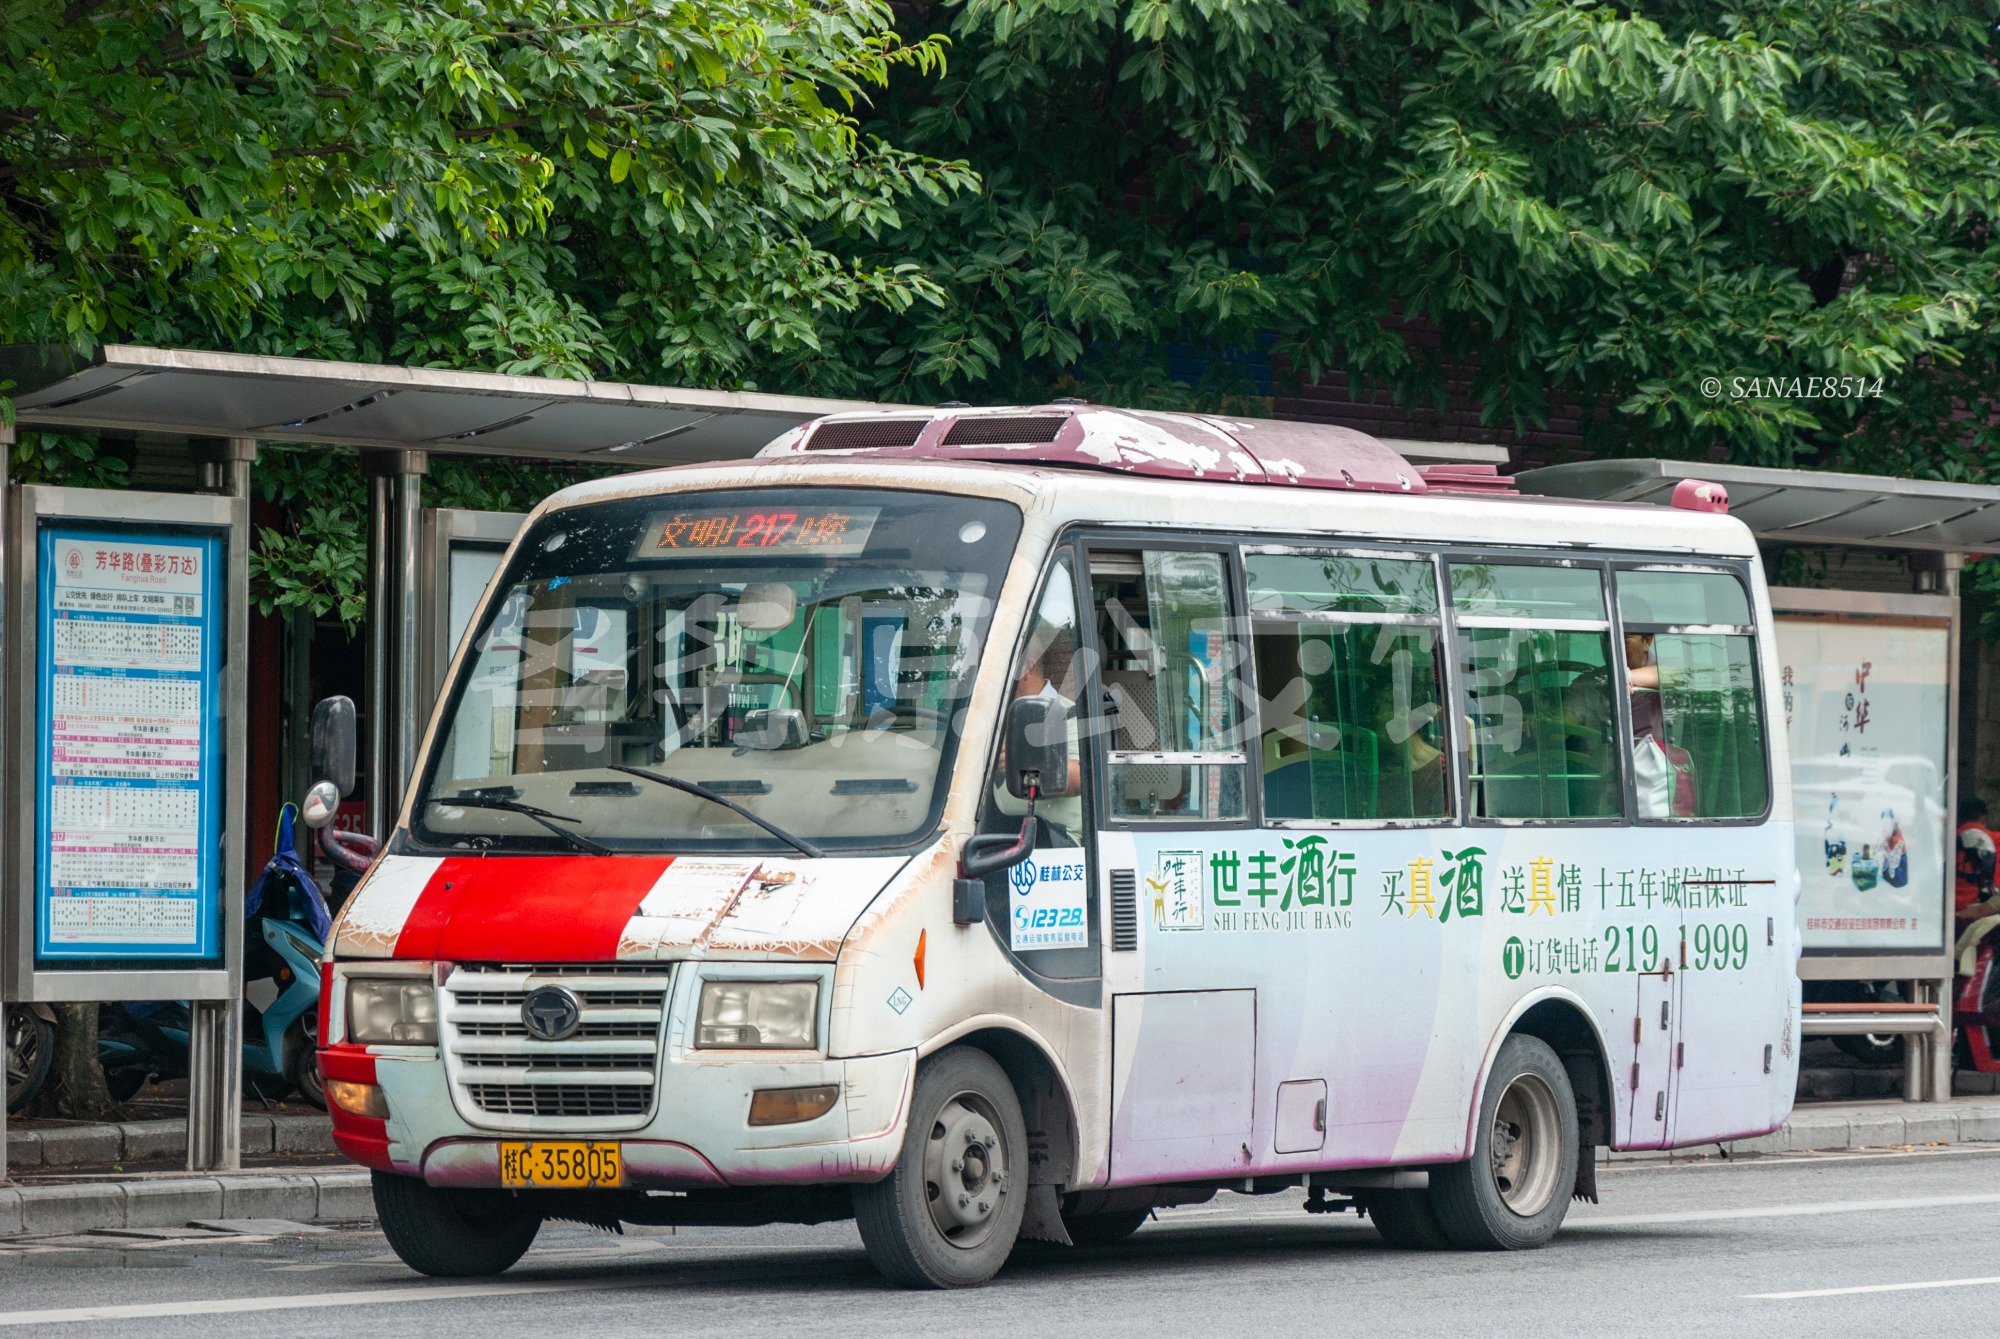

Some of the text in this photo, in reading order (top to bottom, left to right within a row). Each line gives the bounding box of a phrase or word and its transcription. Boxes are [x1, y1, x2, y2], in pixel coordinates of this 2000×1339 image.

[736, 513, 798, 546] 217
[95, 550, 197, 575] 芳华路(叠彩万达)
[121, 573, 167, 584] Fanghua Road
[65, 590, 165, 604] 公交优先 绿色出行 排队上车 文明乘车
[53, 720, 66, 730] 211
[53, 747, 65, 757] 211
[53, 832, 65, 841] 217
[1040, 864, 1084, 882] 桂林公交
[1210, 835, 1357, 912] 世丰酒行
[1380, 846, 1749, 924] 买真酒 送真情 十五年诚信保证
[1031, 907, 1083, 928] 12328
[1213, 911, 1352, 932] SHI FENG JIU HANG
[1527, 923, 1749, 975] 订货电话 219 1999
[893, 996, 907, 1006] LNG
[503, 1148, 618, 1181] 桂C·35805
